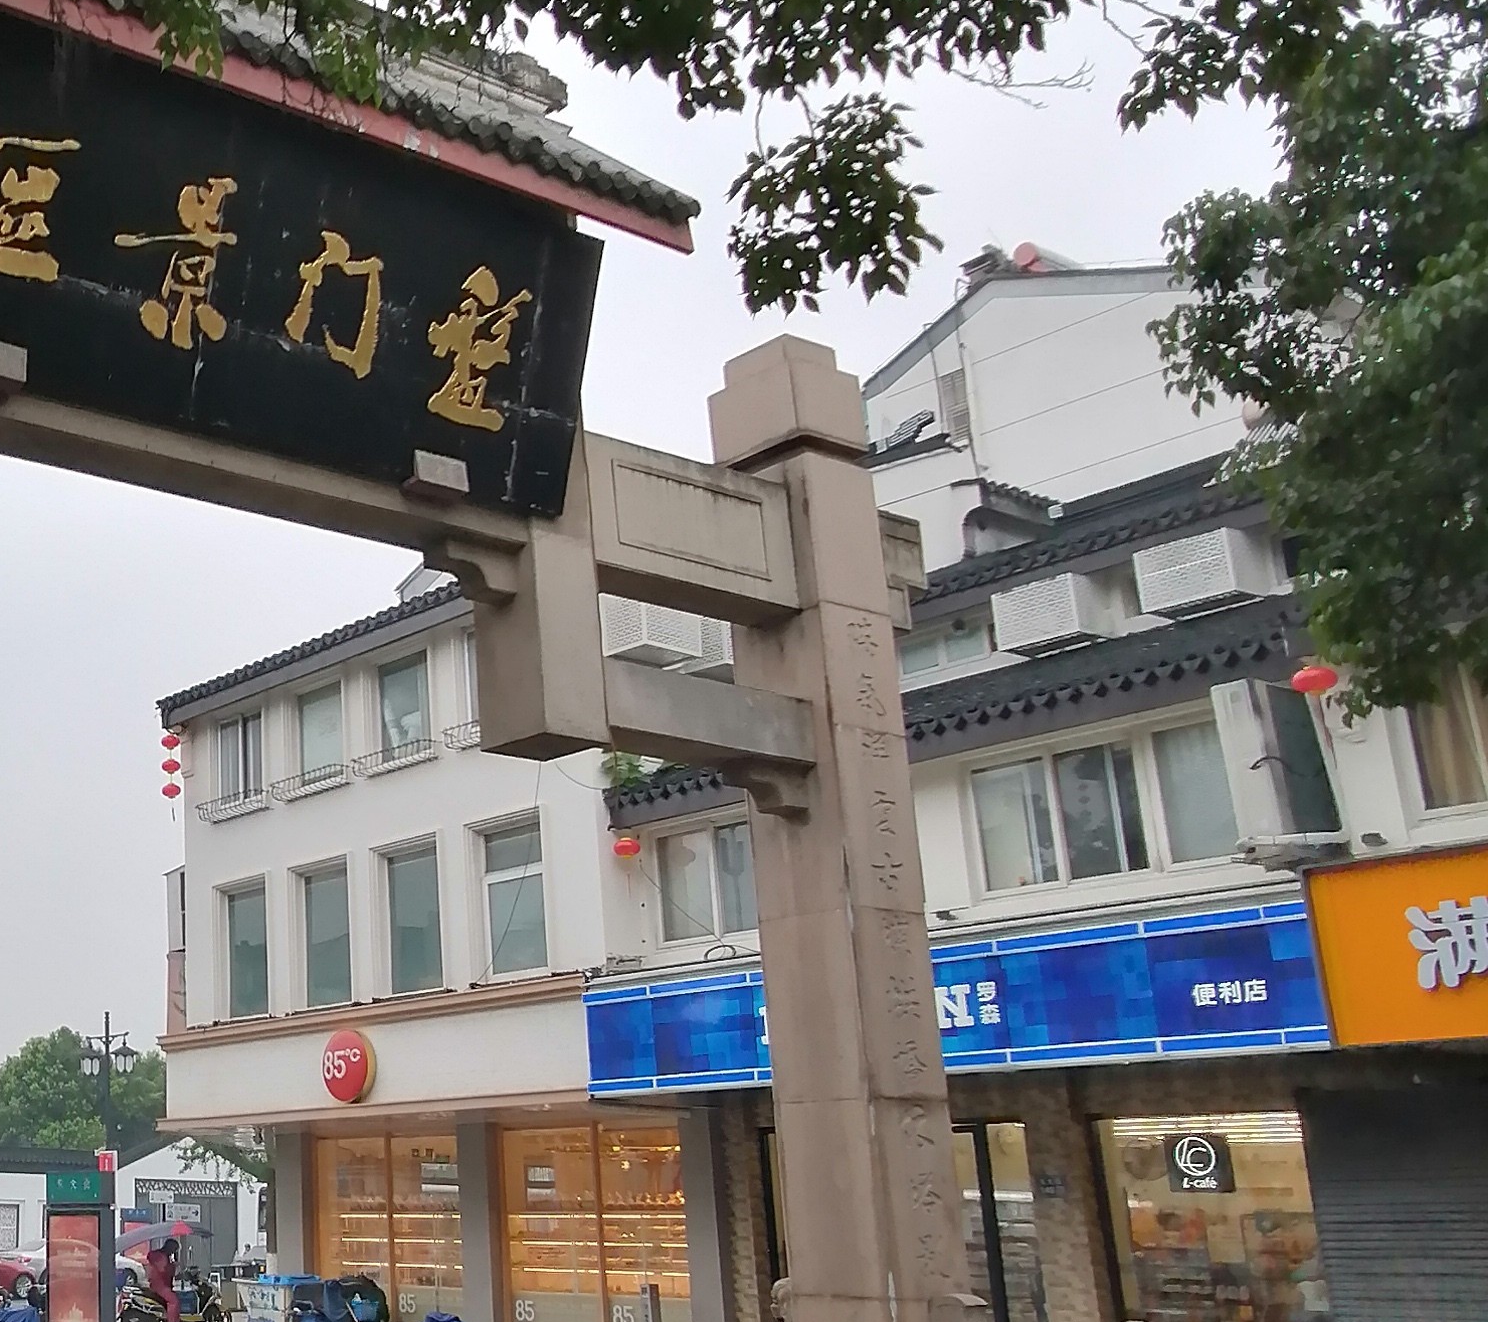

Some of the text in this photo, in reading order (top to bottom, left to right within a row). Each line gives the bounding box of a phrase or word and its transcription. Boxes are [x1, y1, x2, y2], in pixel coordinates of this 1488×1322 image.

[976, 981, 1001, 1024] 罗森
[1191, 979, 1268, 1006] 便利店
[398, 1293, 416, 1314] 85
[515, 1299, 535, 1322] 85
